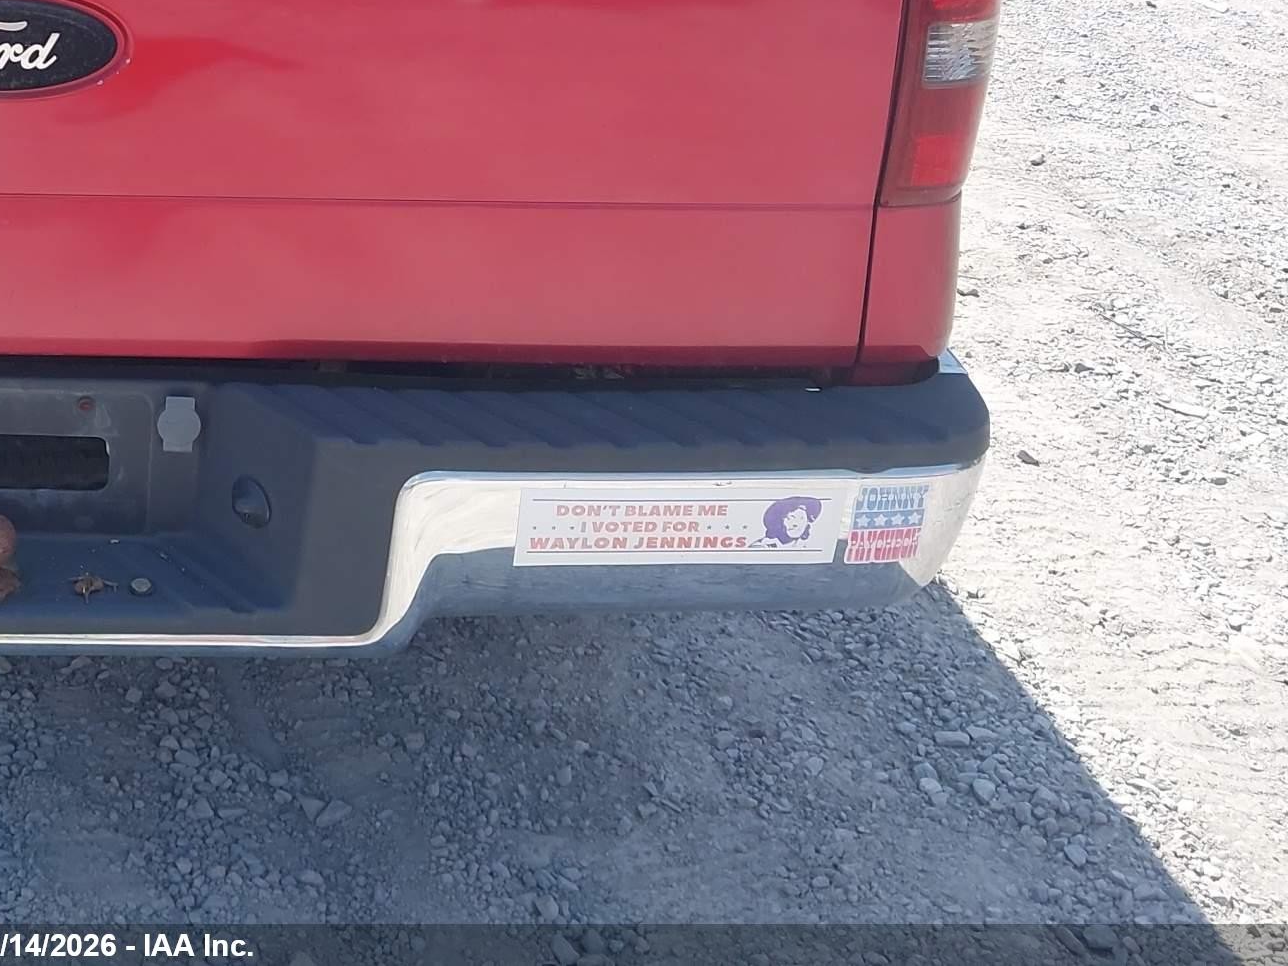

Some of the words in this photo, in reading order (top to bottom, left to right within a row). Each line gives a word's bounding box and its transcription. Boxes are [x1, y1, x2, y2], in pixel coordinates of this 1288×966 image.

[857, 485, 929, 512] JOHNNY
[625, 505, 694, 517] BLAME
[698, 505, 728, 517] ME
[580, 521, 586, 533] I
[592, 521, 659, 533] VOTED
[662, 521, 700, 533] FOR
[529, 536, 628, 550] WAYLON
[633, 536, 748, 550] JENNINGS
